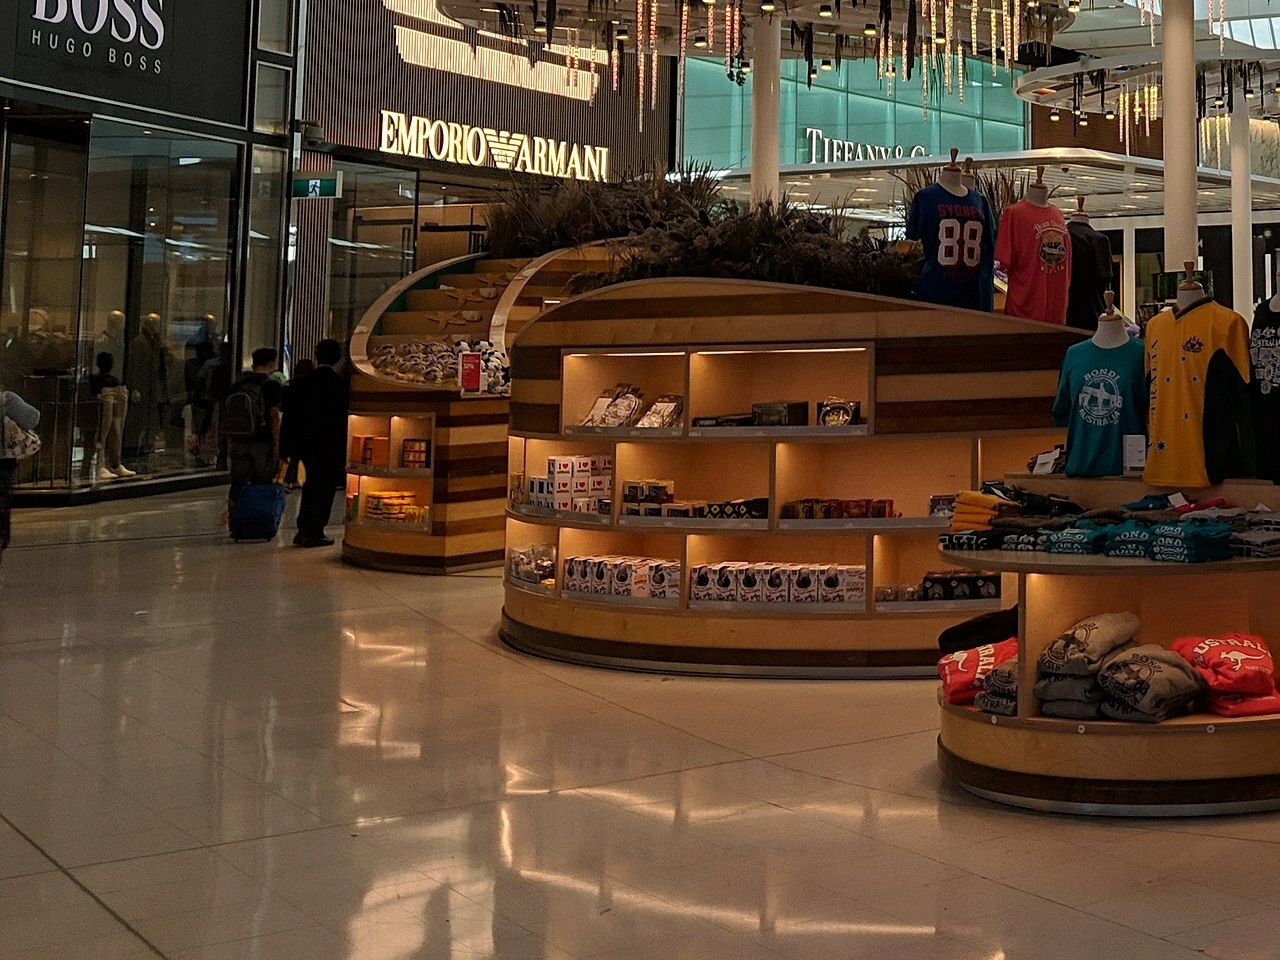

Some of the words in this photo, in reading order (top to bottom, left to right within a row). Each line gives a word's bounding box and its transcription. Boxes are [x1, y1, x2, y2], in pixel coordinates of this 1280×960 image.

[31, 29, 92, 57] HUGO
[108, 47, 161, 74] BOSS
[379, 110, 487, 166] EMPORIO
[514, 135, 609, 183] ARMANI
[937, 218, 984, 267] 88
[1083, 368, 1121, 381] BONDI
[1079, 408, 1121, 427] AUSTRALIA
